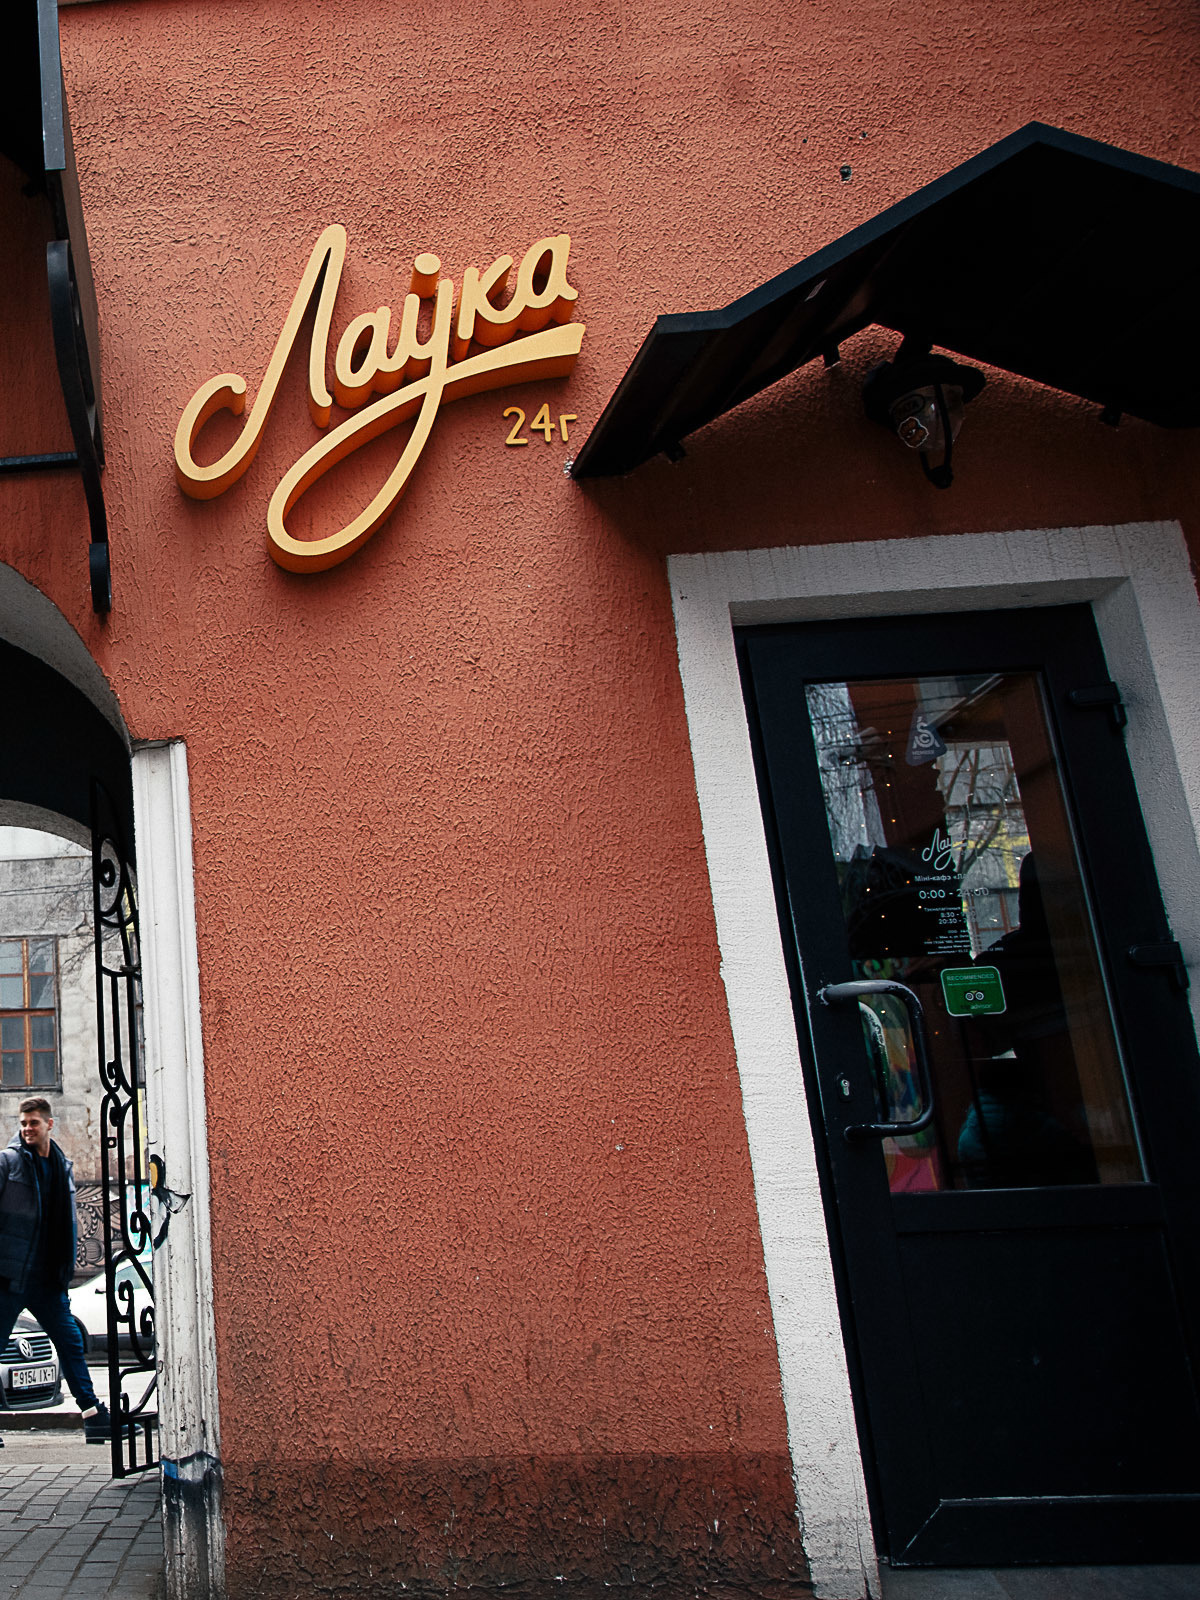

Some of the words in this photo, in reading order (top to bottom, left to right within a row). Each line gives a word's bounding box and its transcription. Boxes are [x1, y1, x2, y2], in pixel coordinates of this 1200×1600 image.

[502, 402, 578, 446] 24г
[918, 888, 946, 900] 0:00
[19, 1370, 37, 1385] 9154
